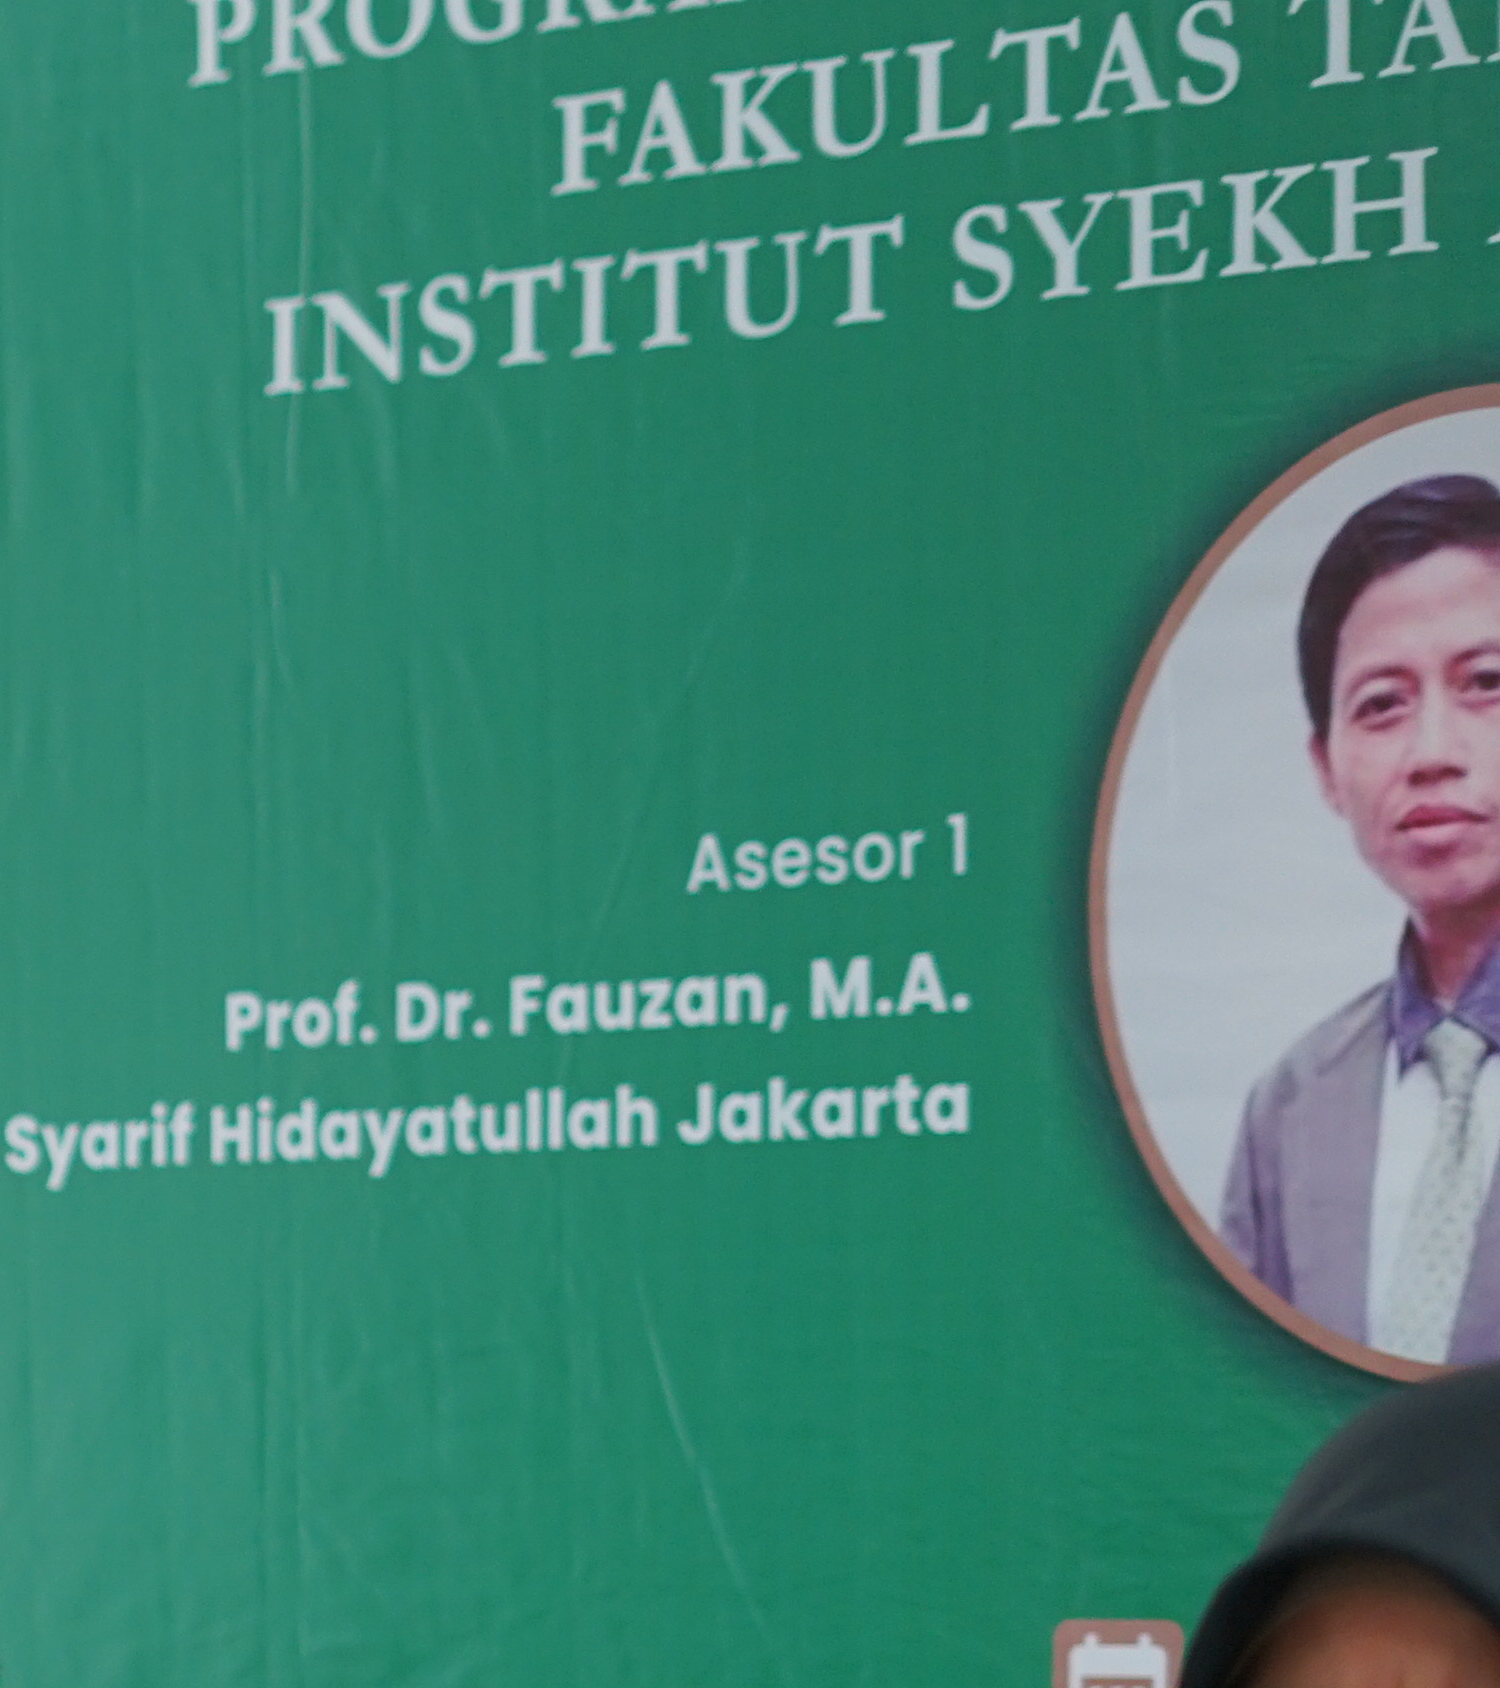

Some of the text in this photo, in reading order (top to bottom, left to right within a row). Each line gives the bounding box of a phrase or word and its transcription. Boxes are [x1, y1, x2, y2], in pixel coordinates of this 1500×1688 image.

[553, 0, 1500, 194] FAKULTAS TA
[265, 147, 1438, 395] INSTITUT SYEKH
[687, 814, 966, 892] Asesor 1
[226, 953, 969, 1051] Prof. Dr. Fauzan, M.A.
[5, 1102, 194, 1191] Syarif
[210, 1085, 657, 1177] Hidayatullah
[678, 1075, 968, 1143] Jakarta
